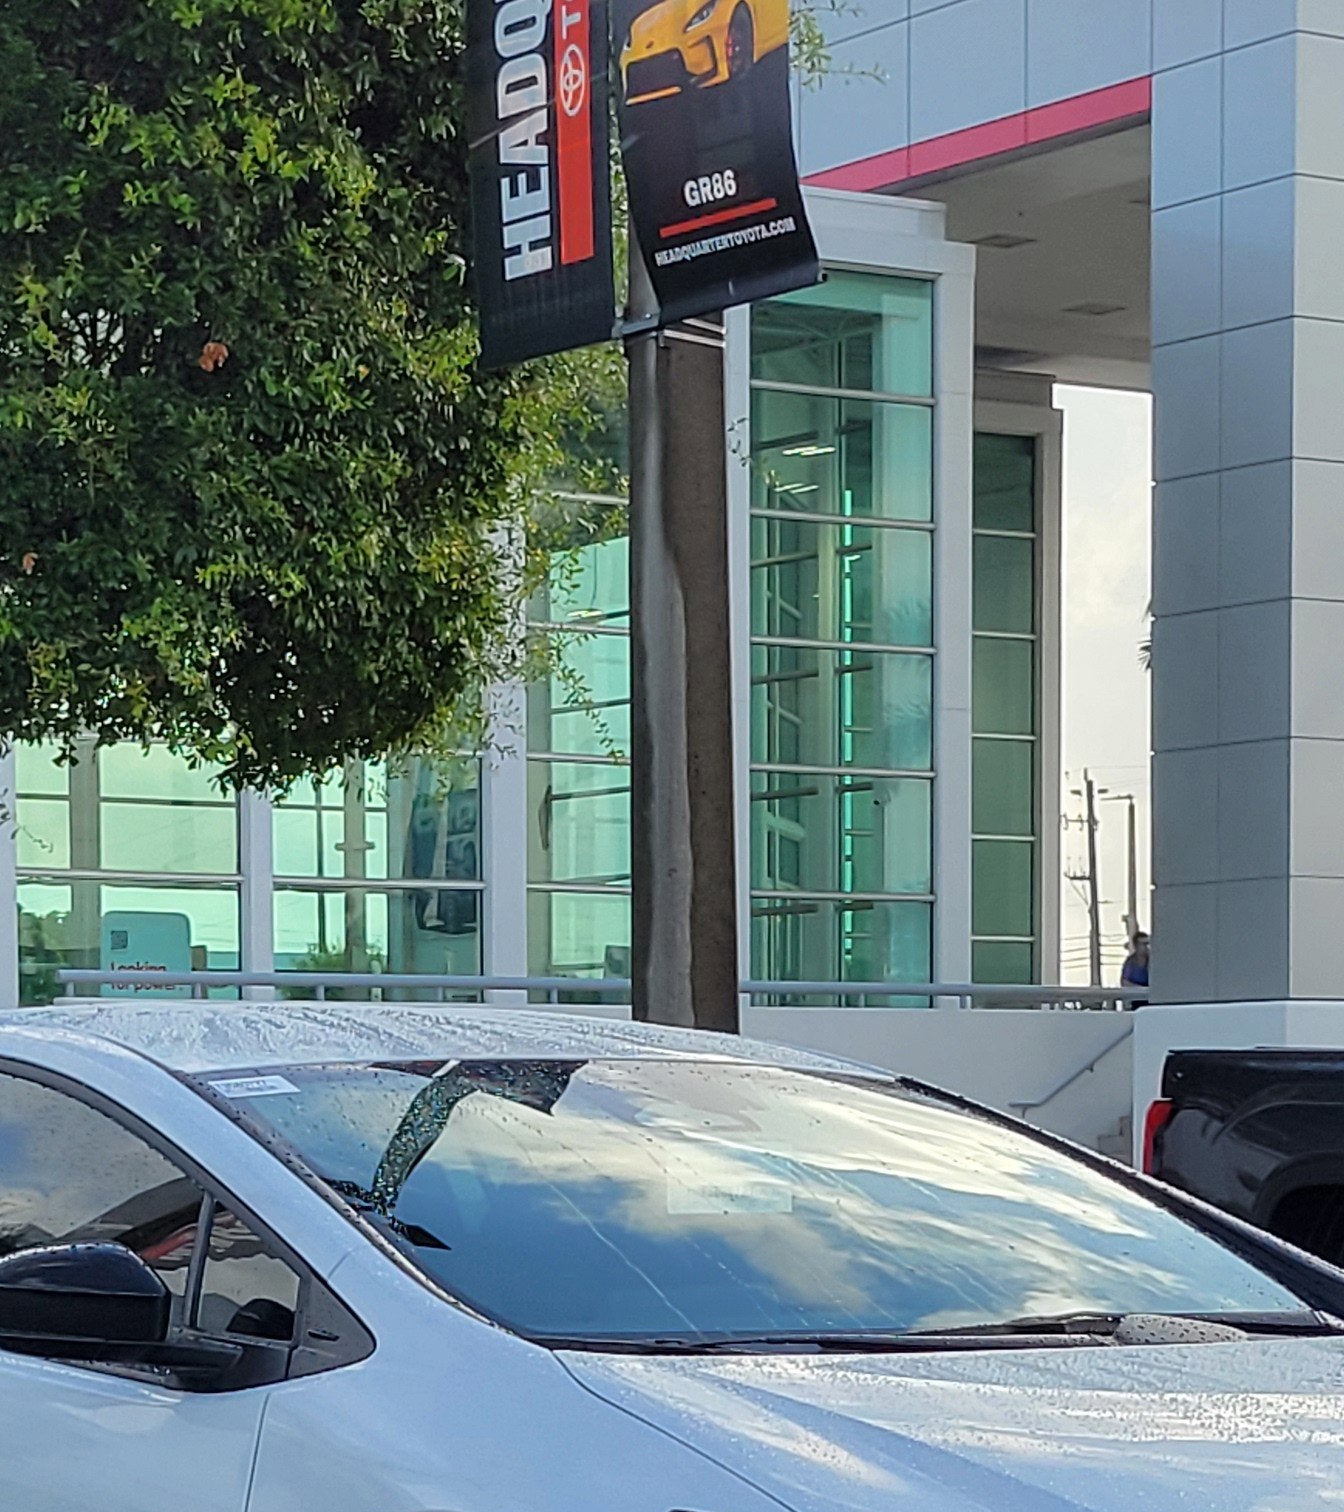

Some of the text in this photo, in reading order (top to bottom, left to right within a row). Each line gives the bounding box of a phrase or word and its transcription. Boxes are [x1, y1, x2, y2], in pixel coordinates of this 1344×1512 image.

[561, 0, 582, 40] T
[494, 0, 553, 281] HEADQ
[683, 168, 738, 207] GR86
[654, 215, 797, 267] HEADQUARTERTOYOTA.COM
